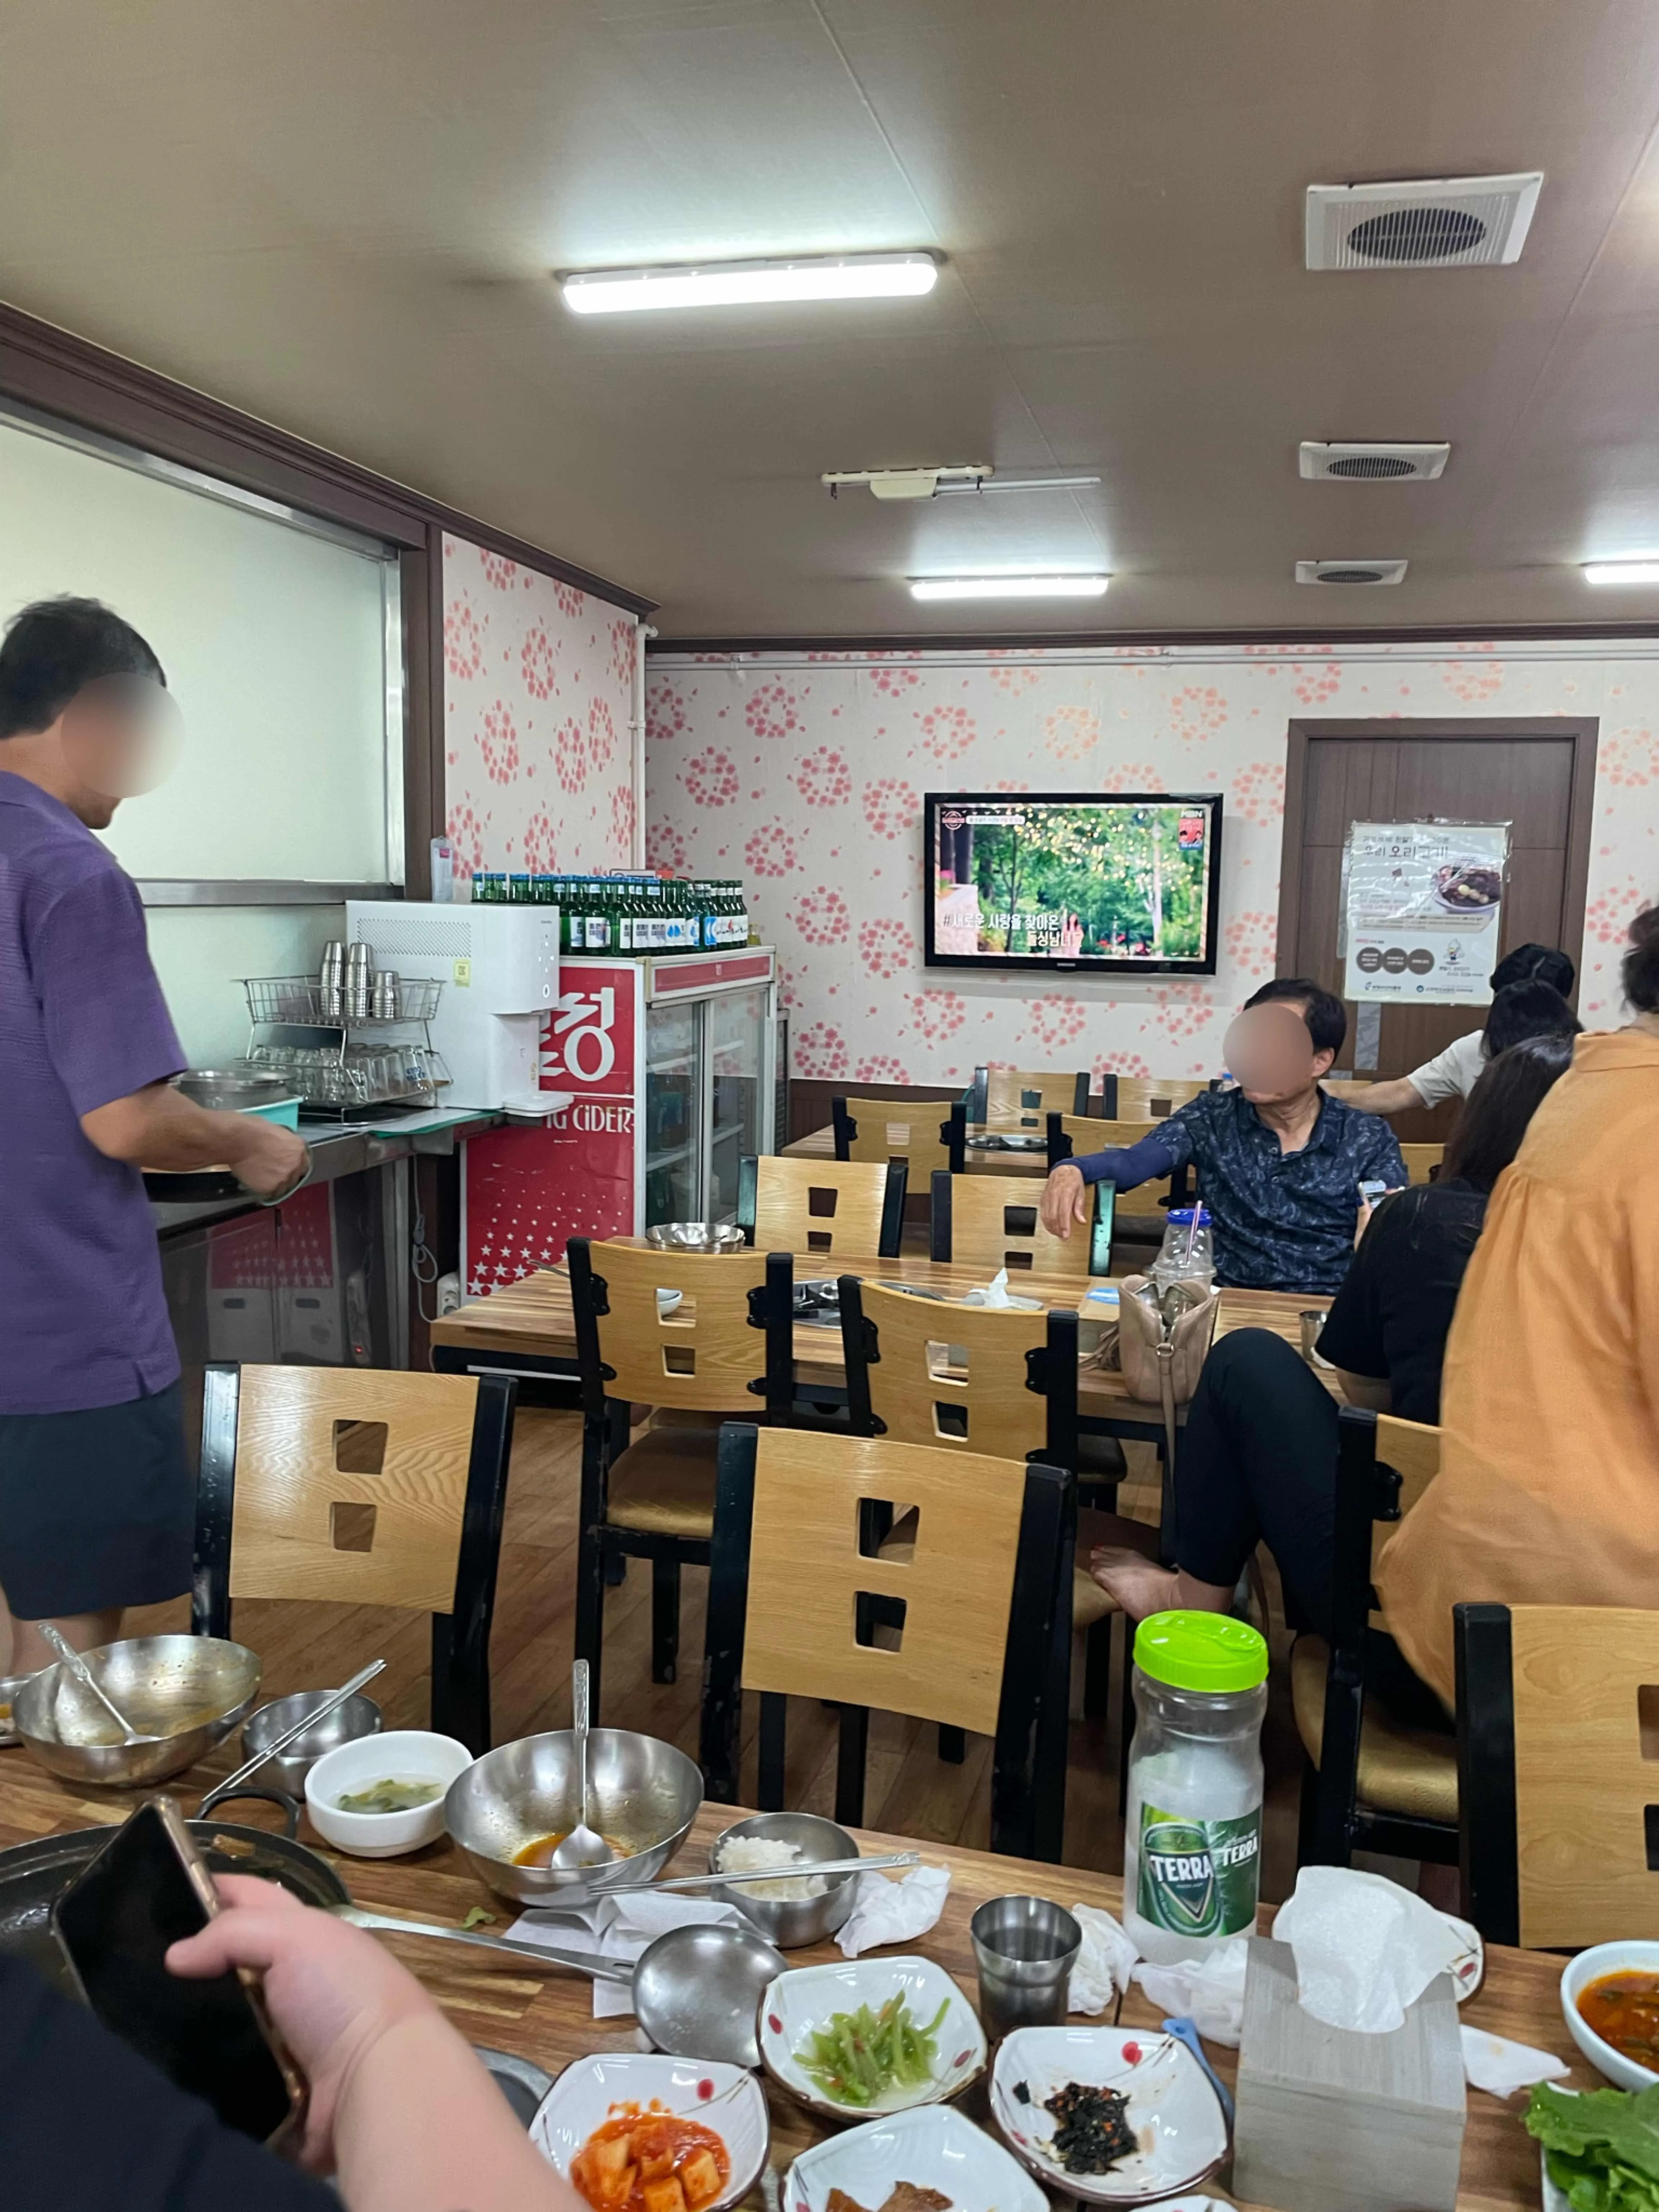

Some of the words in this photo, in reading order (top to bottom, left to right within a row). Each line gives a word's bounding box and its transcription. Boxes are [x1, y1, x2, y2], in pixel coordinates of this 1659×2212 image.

[988, 913, 1021, 930] 사랑을
[1025, 914, 1060, 931] 찾아온
[1222, 1836, 1258, 1867] TERRA
[1150, 1855, 1214, 1882] TERRA
